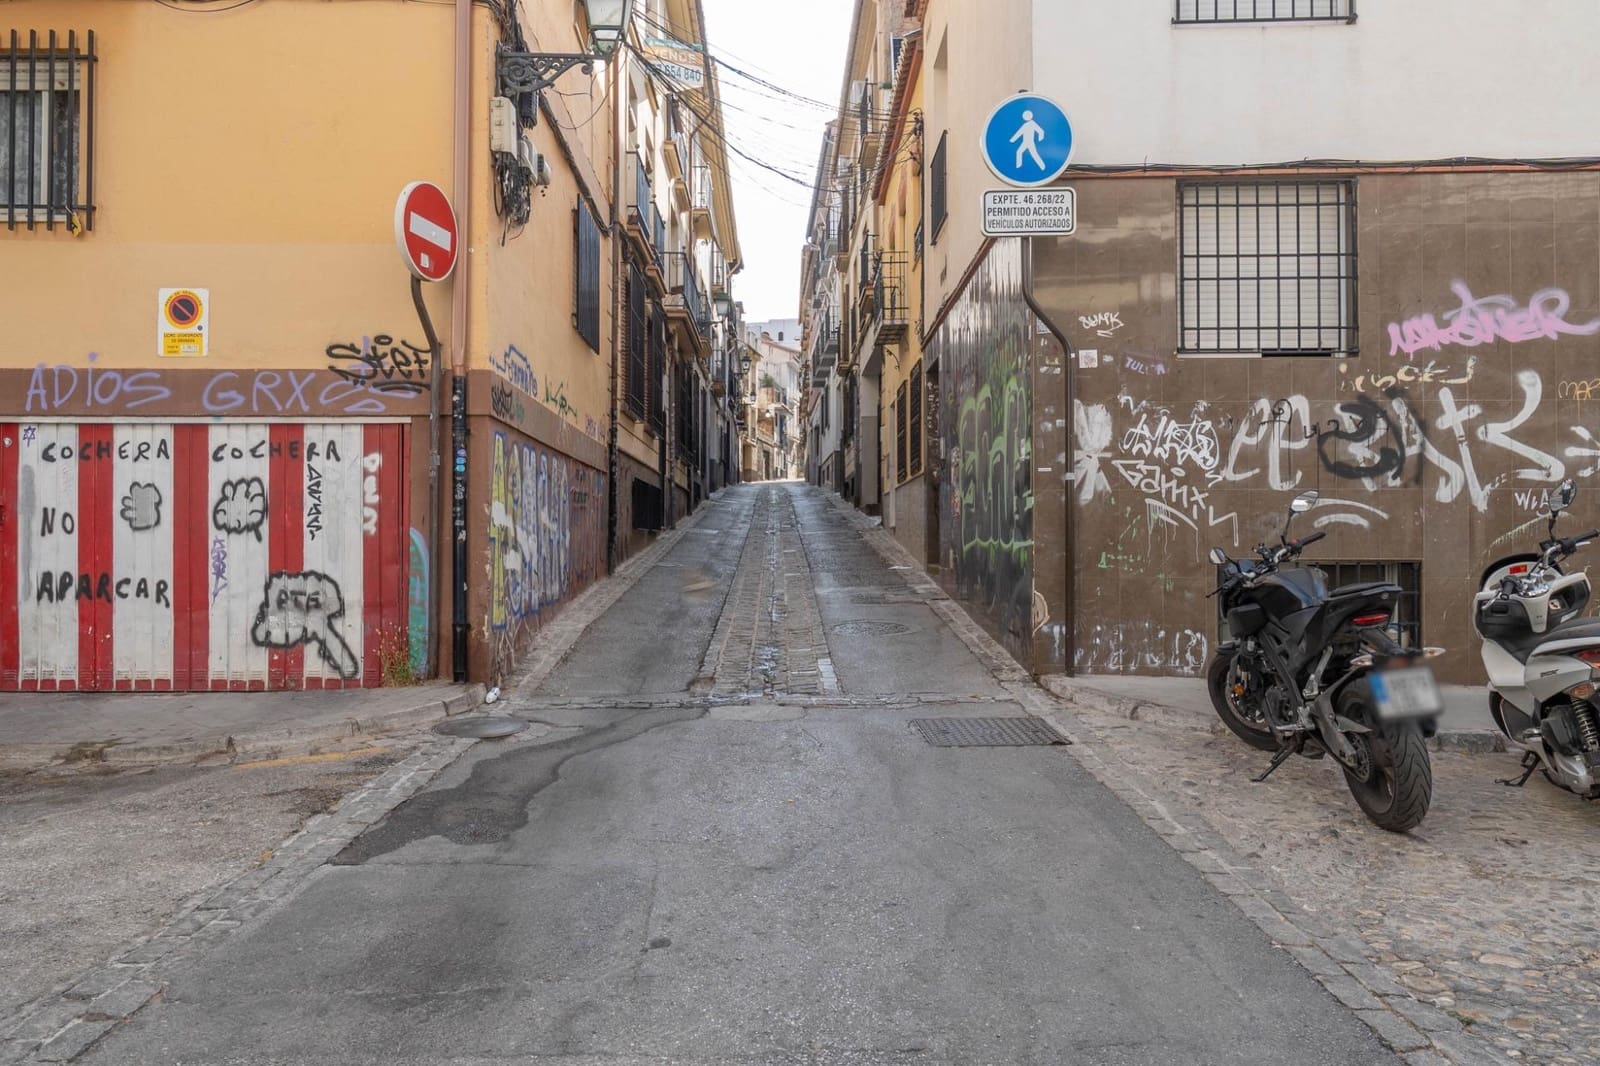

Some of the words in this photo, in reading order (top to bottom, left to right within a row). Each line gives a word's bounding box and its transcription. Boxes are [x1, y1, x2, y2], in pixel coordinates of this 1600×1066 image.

[987, 206, 1031, 217] PERMITIDO
[1032, 206, 1064, 217] ACCESO
[1064, 206, 1071, 216] A
[992, 194, 1022, 205] EXPTE.
[1023, 194, 1065, 204] 46.268/22
[987, 217, 1024, 229] VEHÍCULOS
[1024, 218, 1071, 229] AUTORIZADOS
[41, 438, 171, 462] COCHERA
[212, 439, 341, 463] COCHERA
[40, 507, 75, 537] NO
[37, 570, 171, 609] APARCAR
